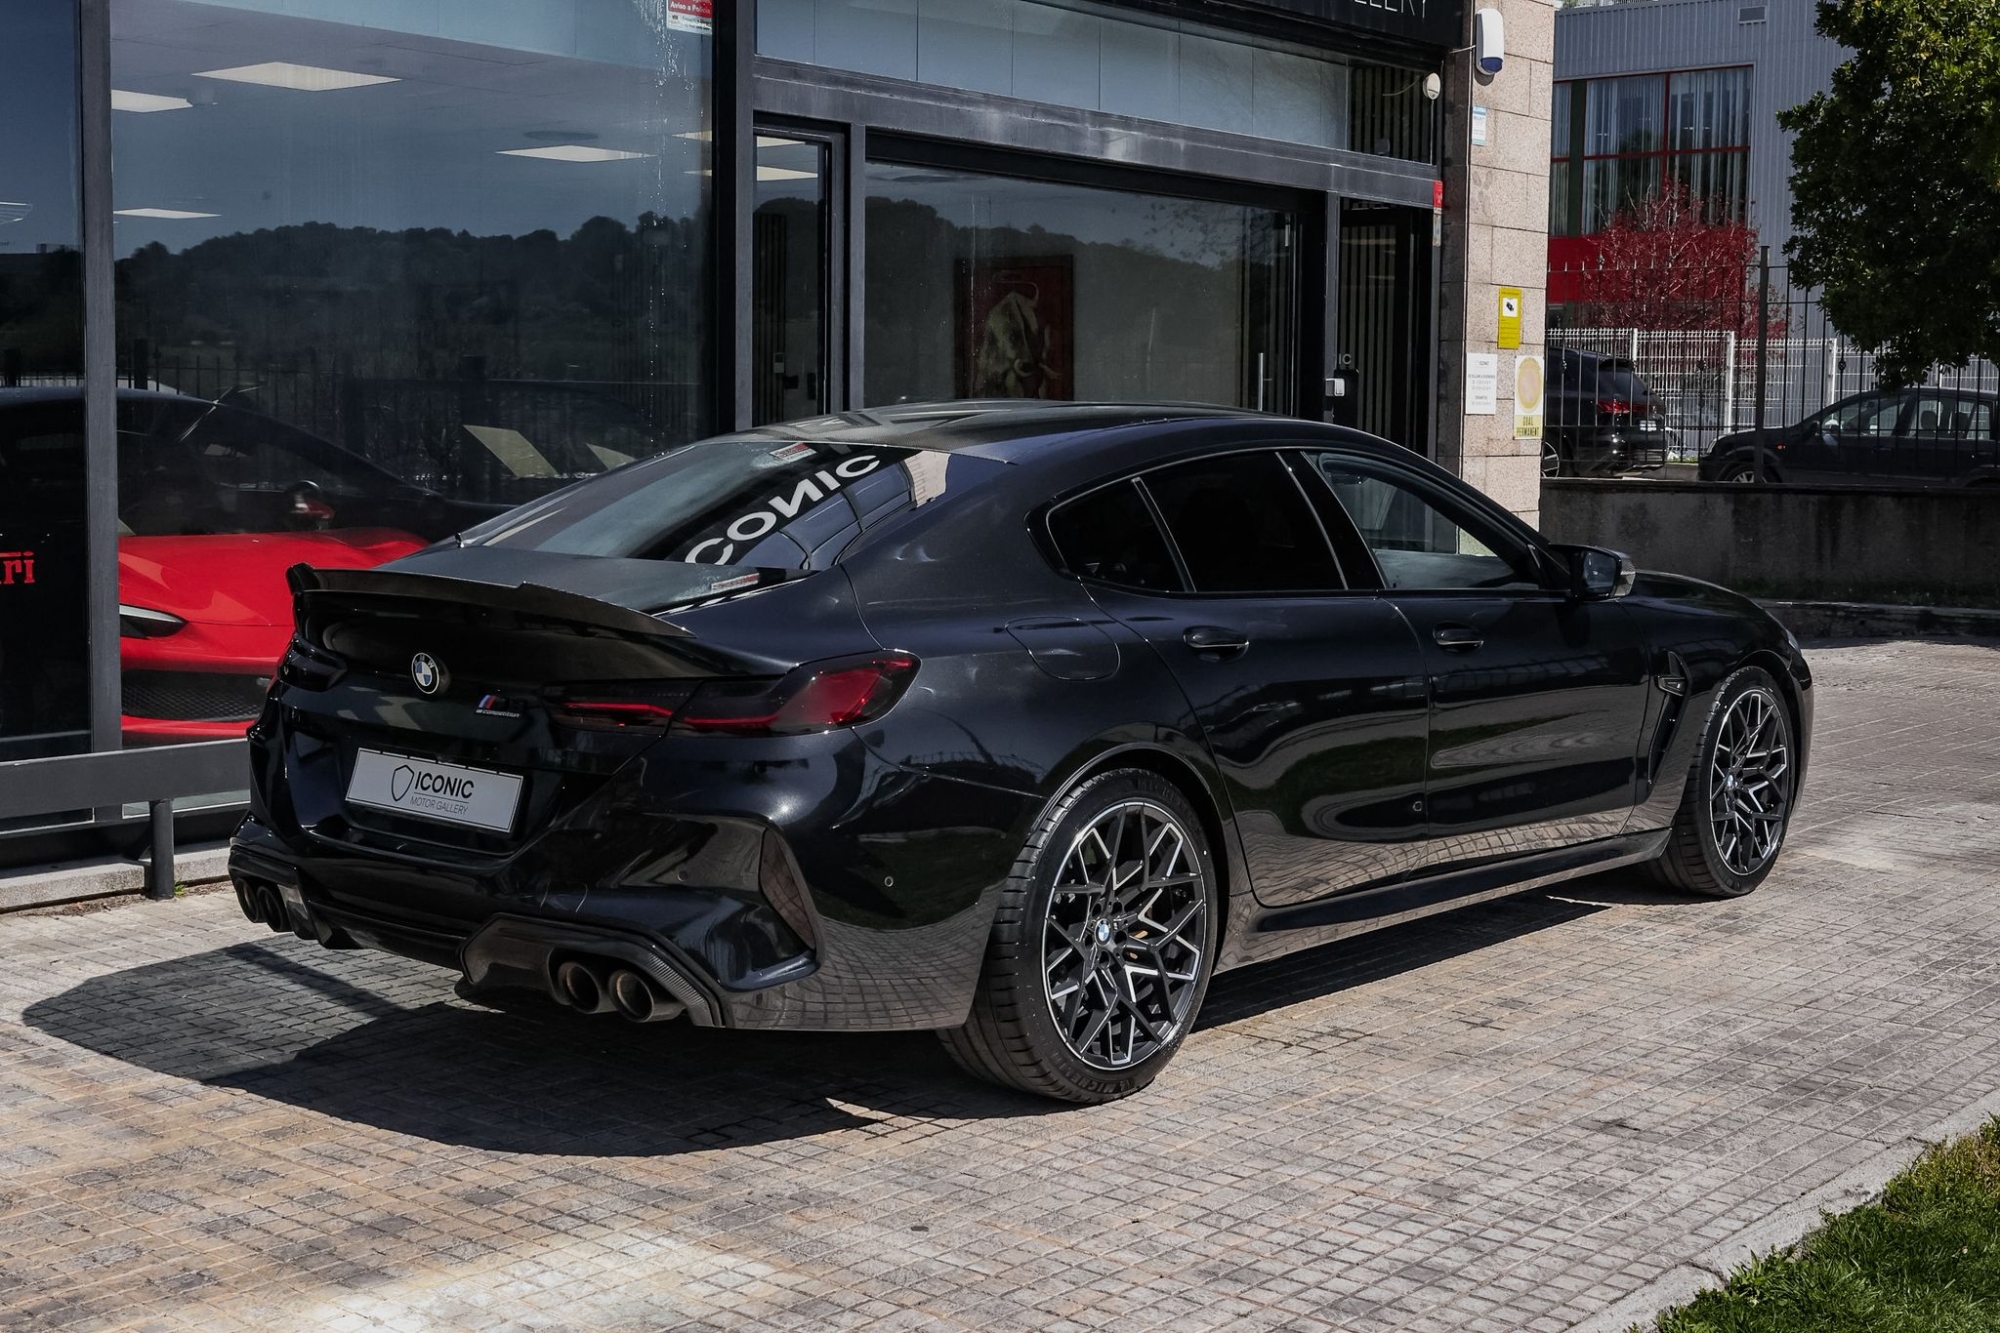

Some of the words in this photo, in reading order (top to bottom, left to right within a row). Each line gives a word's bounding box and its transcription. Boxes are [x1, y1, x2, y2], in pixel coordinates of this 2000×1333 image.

[415, 771, 474, 799] ICONIC
[411, 796, 435, 809] MOTOR
[436, 800, 468, 815] GALLERY
